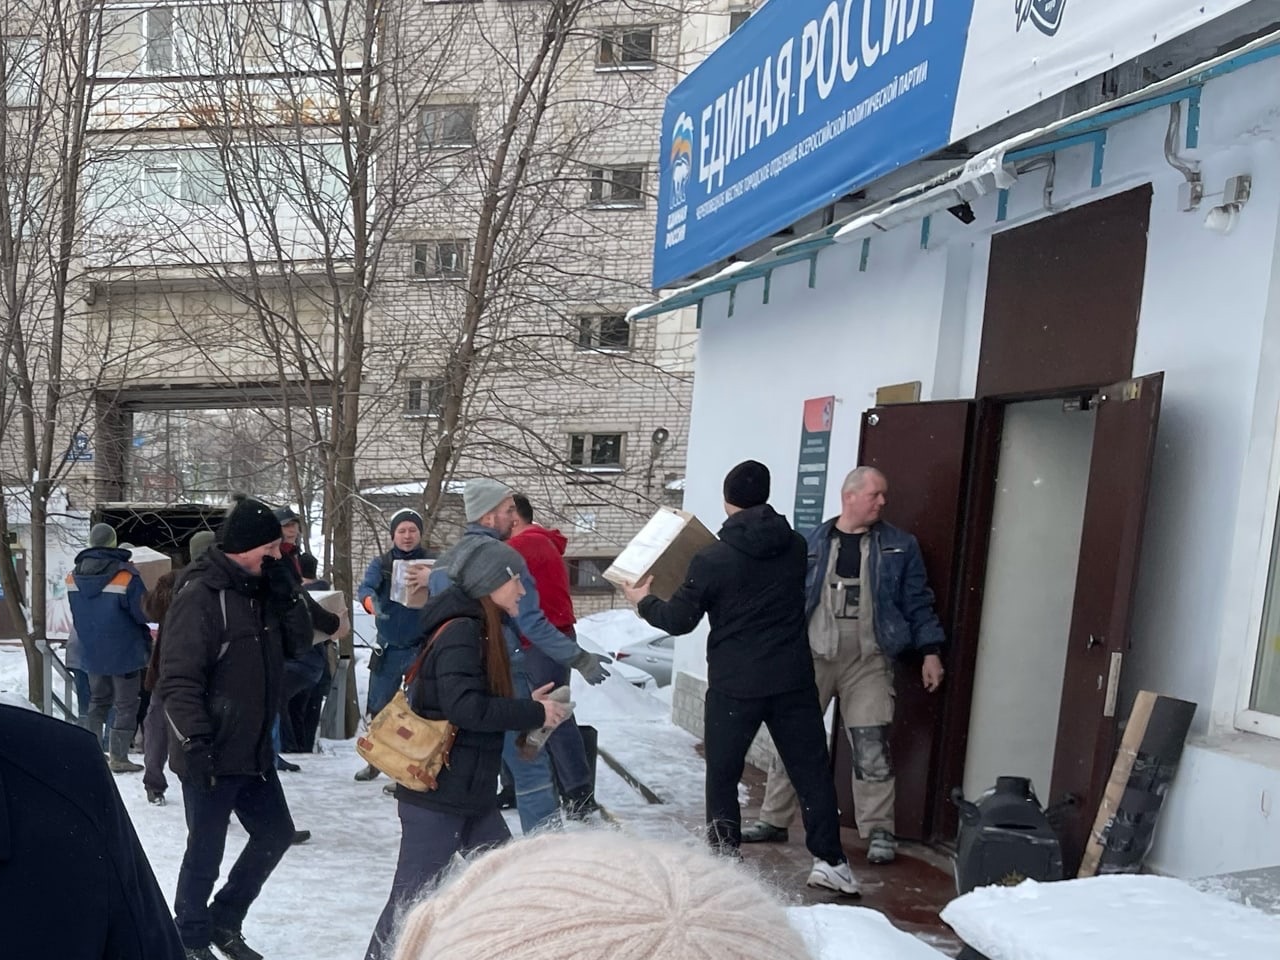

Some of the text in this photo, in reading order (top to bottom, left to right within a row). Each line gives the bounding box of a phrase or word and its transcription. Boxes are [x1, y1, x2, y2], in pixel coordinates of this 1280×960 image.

[699, 37, 794, 194] ЕДИНАЯ
[797, 110, 847, 160] ВСЕРОССИЙСКОЙ
[846, 75, 898, 130] ПОЛИТИЧЕСКОЙ
[897, 59, 929, 97] ПАРТИИ
